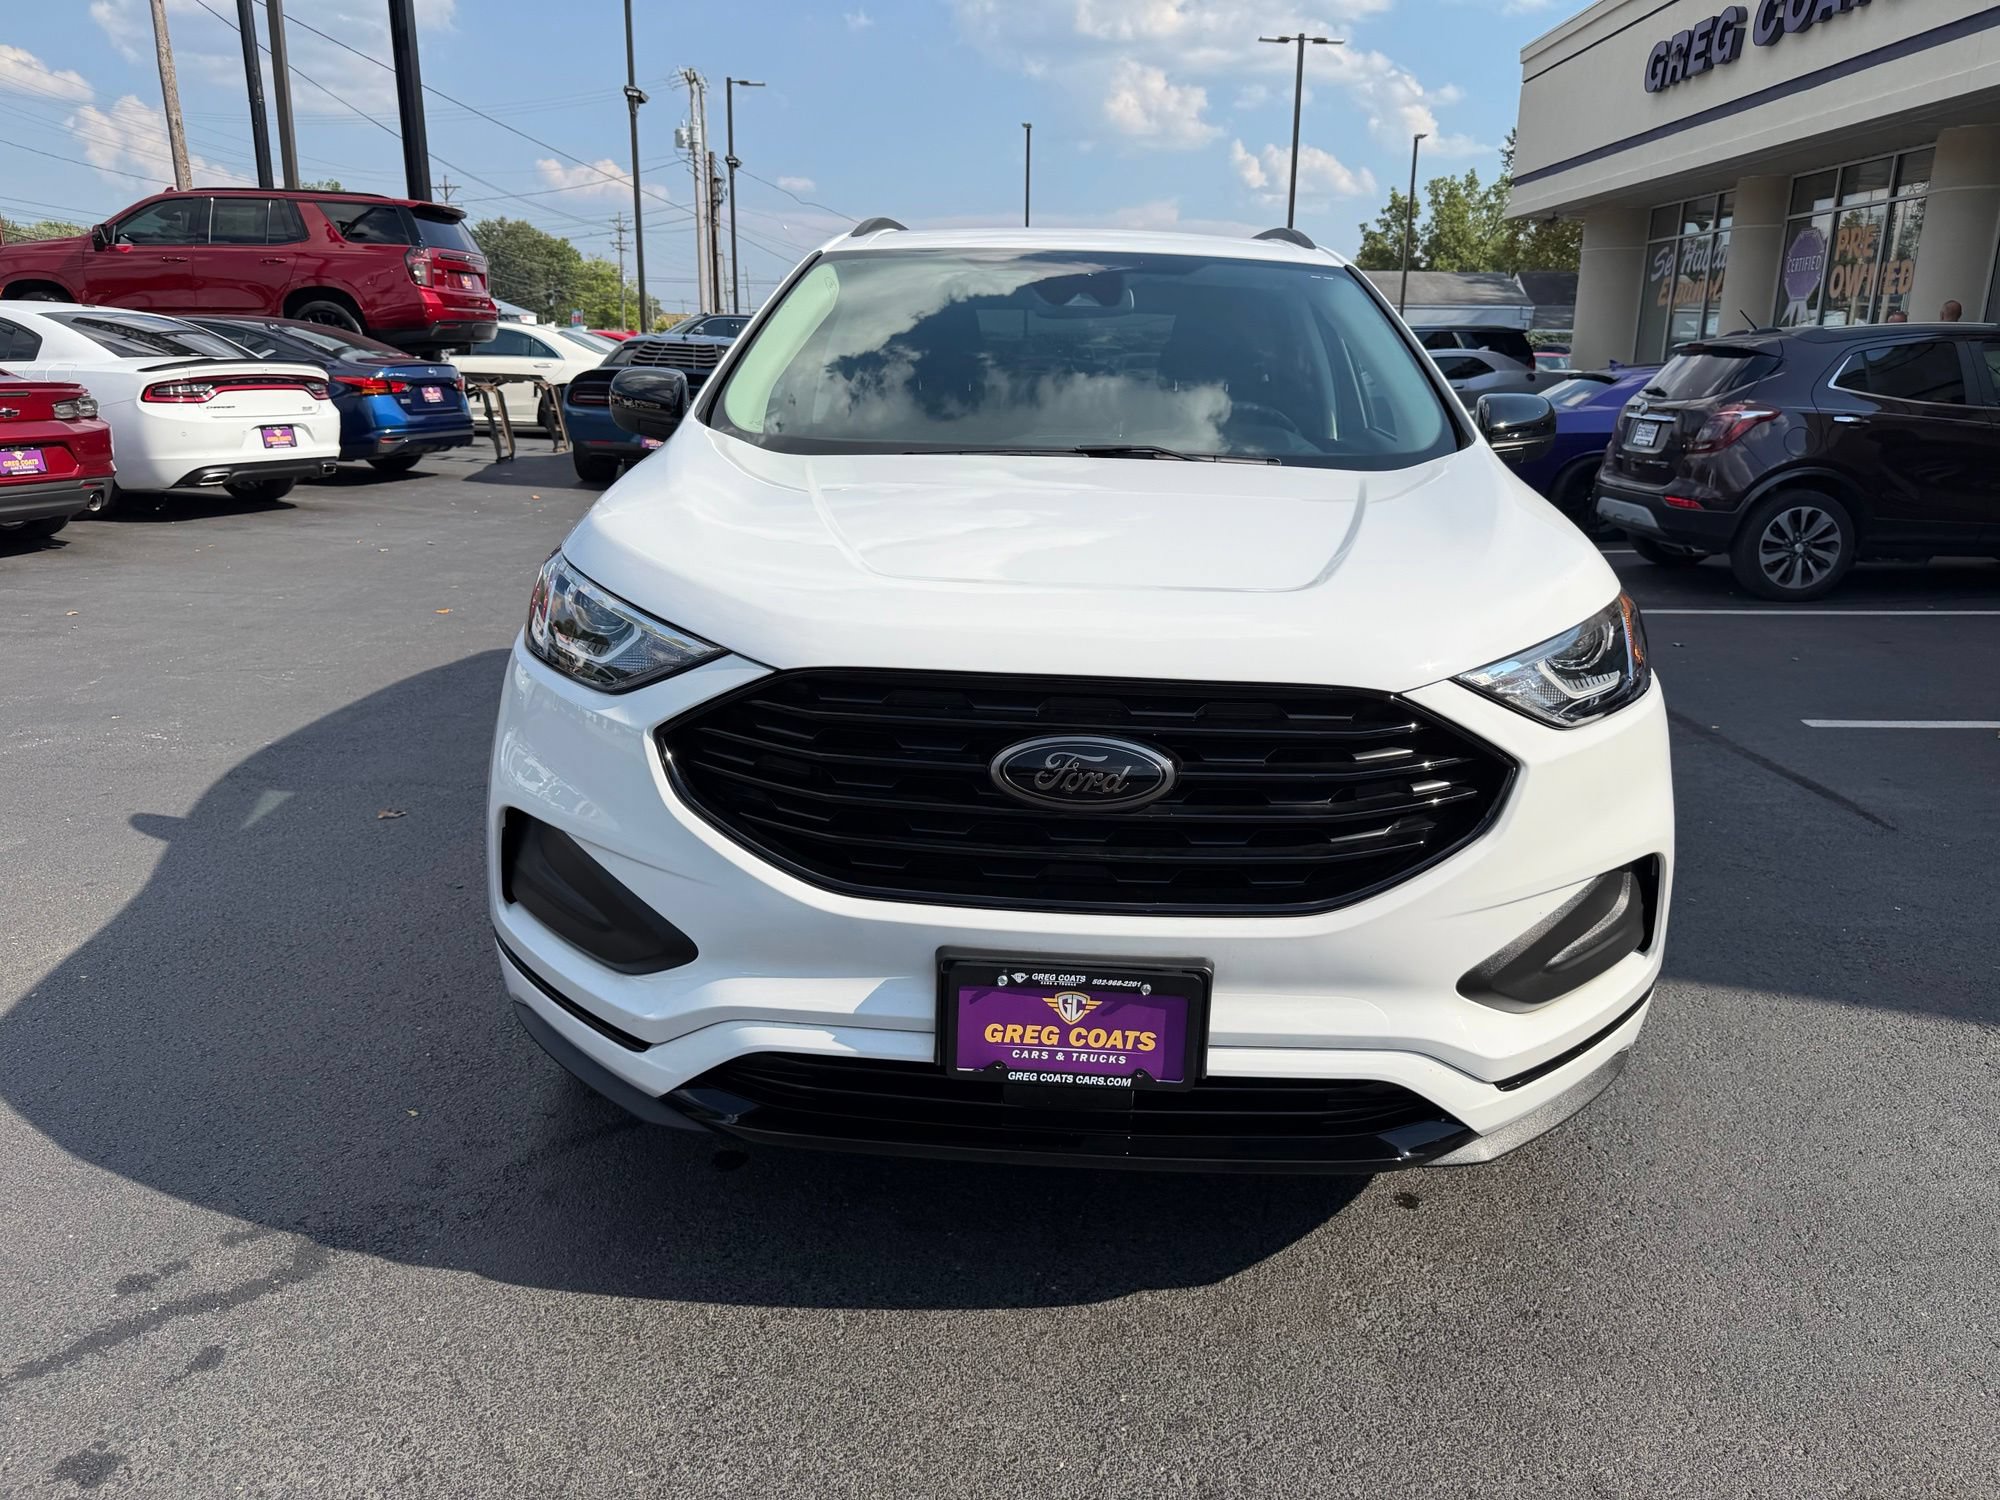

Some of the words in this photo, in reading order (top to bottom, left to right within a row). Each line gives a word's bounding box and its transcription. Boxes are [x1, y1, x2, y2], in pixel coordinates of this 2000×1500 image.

[1644, 5, 1748, 94] GREG
[1835, 224, 1877, 261] PRE
[1650, 246, 1674, 282] Se
[1786, 255, 1822, 273] CERTIFIED
[1828, 258, 1915, 299] OWNED
[1034, 751, 1133, 794] Ford
[1031, 972, 1056, 981] GREG
[1058, 974, 1086, 983] COATS
[984, 1023, 1060, 1046] GREG
[1068, 1027, 1157, 1051] COATS
[1011, 1050, 1049, 1060] CARS
[1056, 1052, 1065, 1061] &
[1072, 1053, 1127, 1064] TRUCKS
[1007, 1071, 1037, 1082] GREG
[1039, 1073, 1074, 1084] COATS
[1075, 1075, 1132, 1087] CARS.COM
